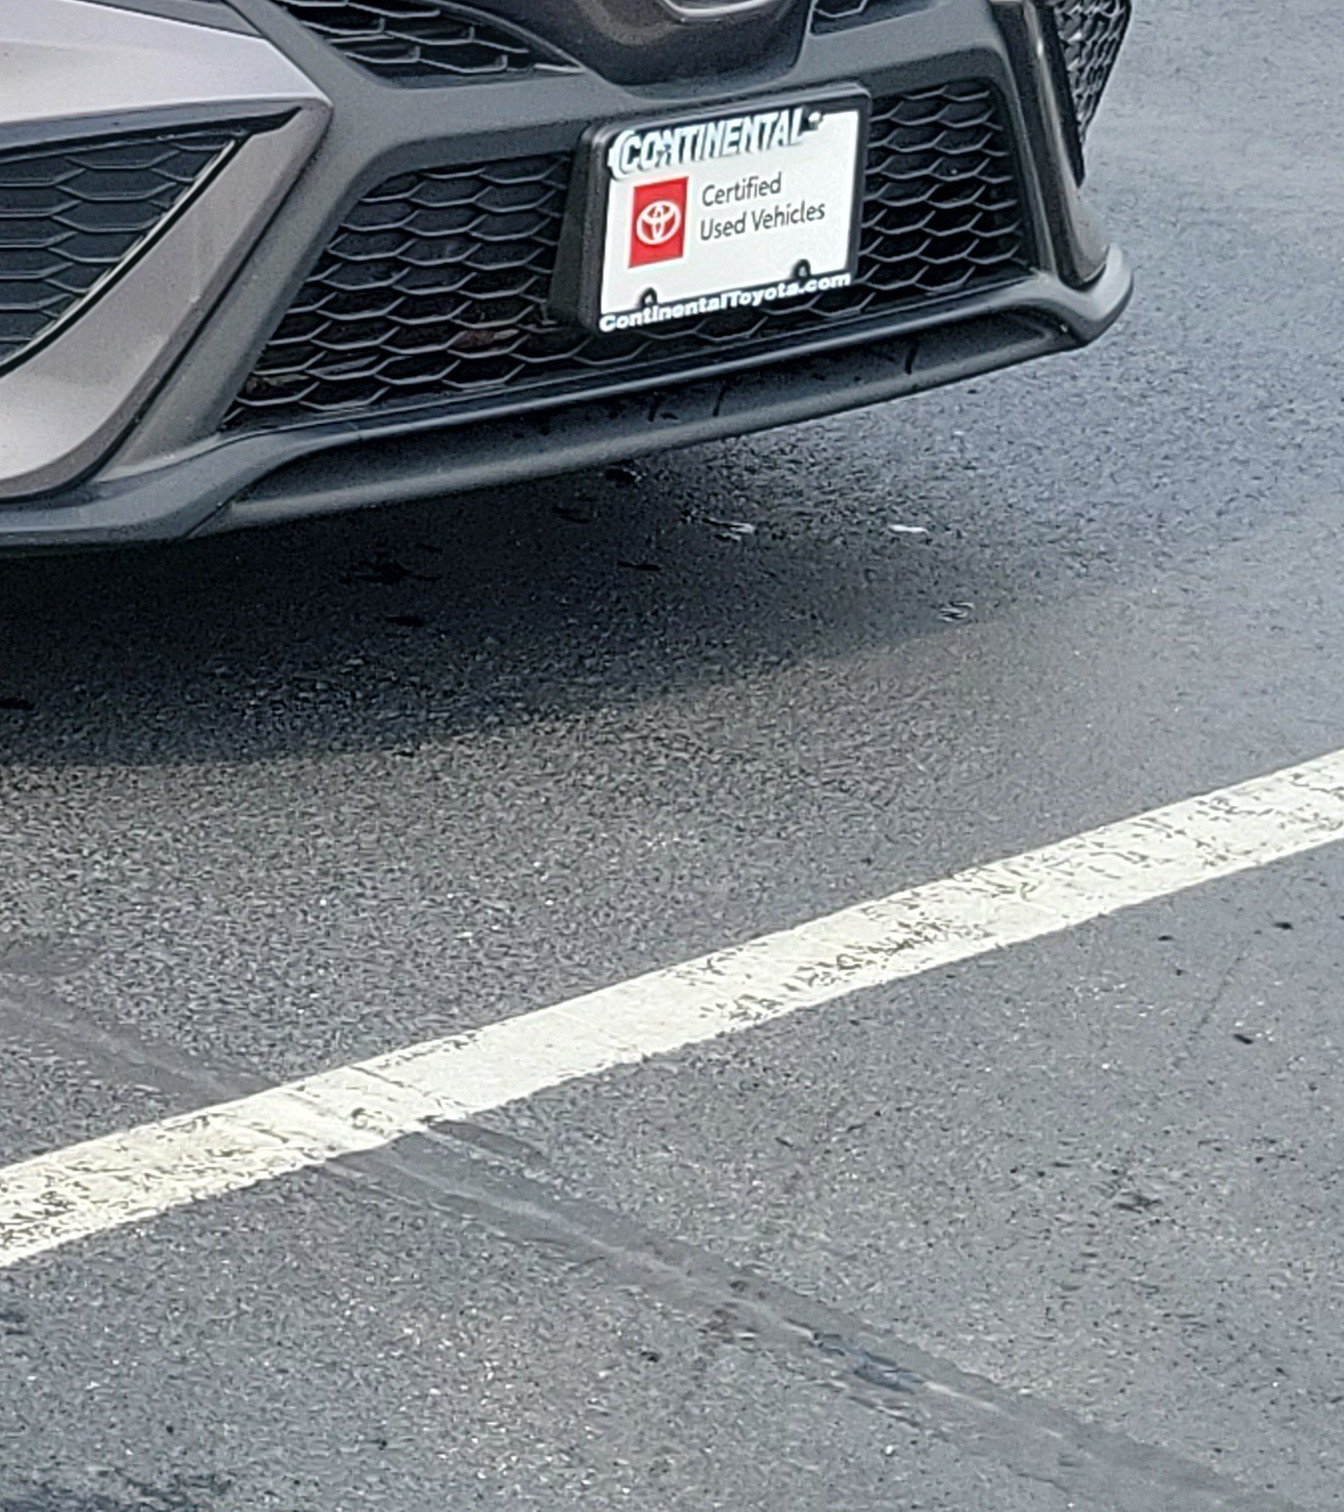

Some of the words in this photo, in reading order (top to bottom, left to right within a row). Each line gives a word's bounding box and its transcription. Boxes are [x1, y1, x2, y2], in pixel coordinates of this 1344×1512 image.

[608, 107, 804, 178] CONTINENTAL
[701, 171, 782, 207] Certified
[700, 211, 747, 241] Used
[751, 199, 826, 232] Vehicles
[599, 273, 851, 333] ContinentalToyota.com
